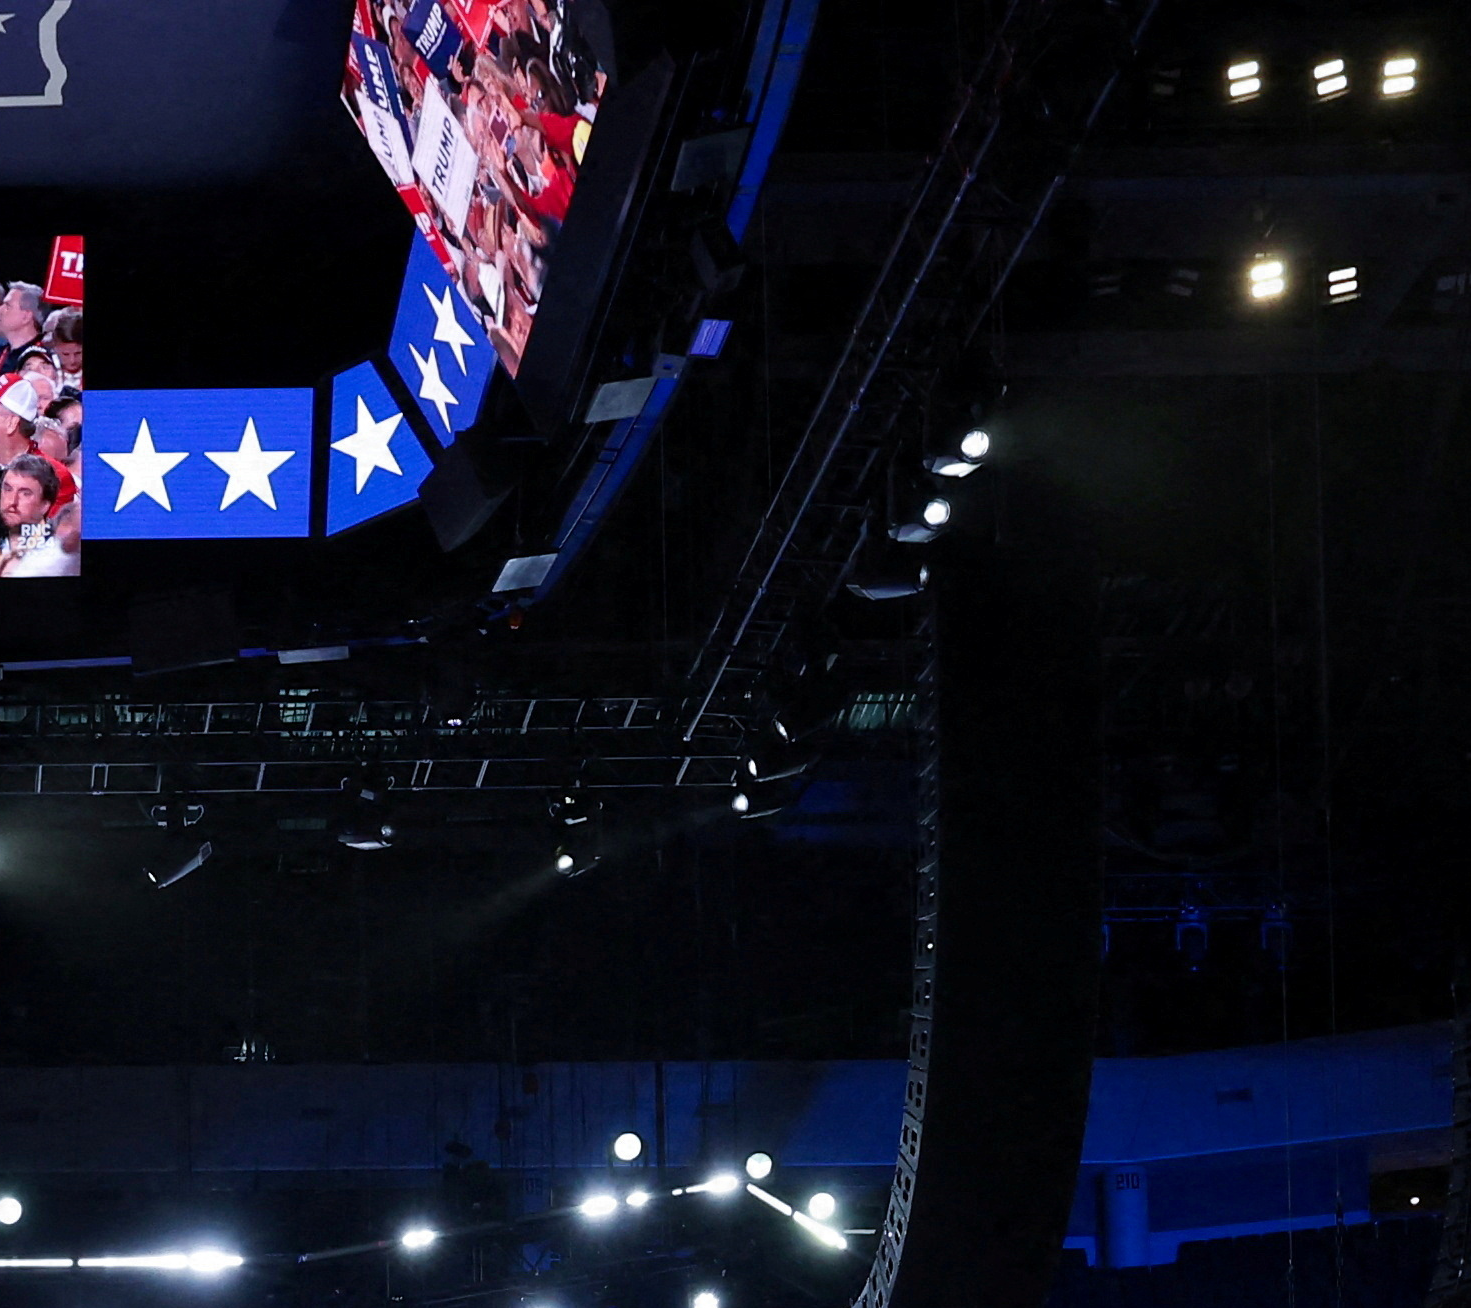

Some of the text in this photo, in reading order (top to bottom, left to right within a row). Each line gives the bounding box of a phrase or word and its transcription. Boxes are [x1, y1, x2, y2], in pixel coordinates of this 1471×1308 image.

[415, 2, 445, 55] TRUMP
[432, 116, 454, 195] TRUMP
[18, 537, 55, 550] 2024
[21, 524, 51, 537] RNC
